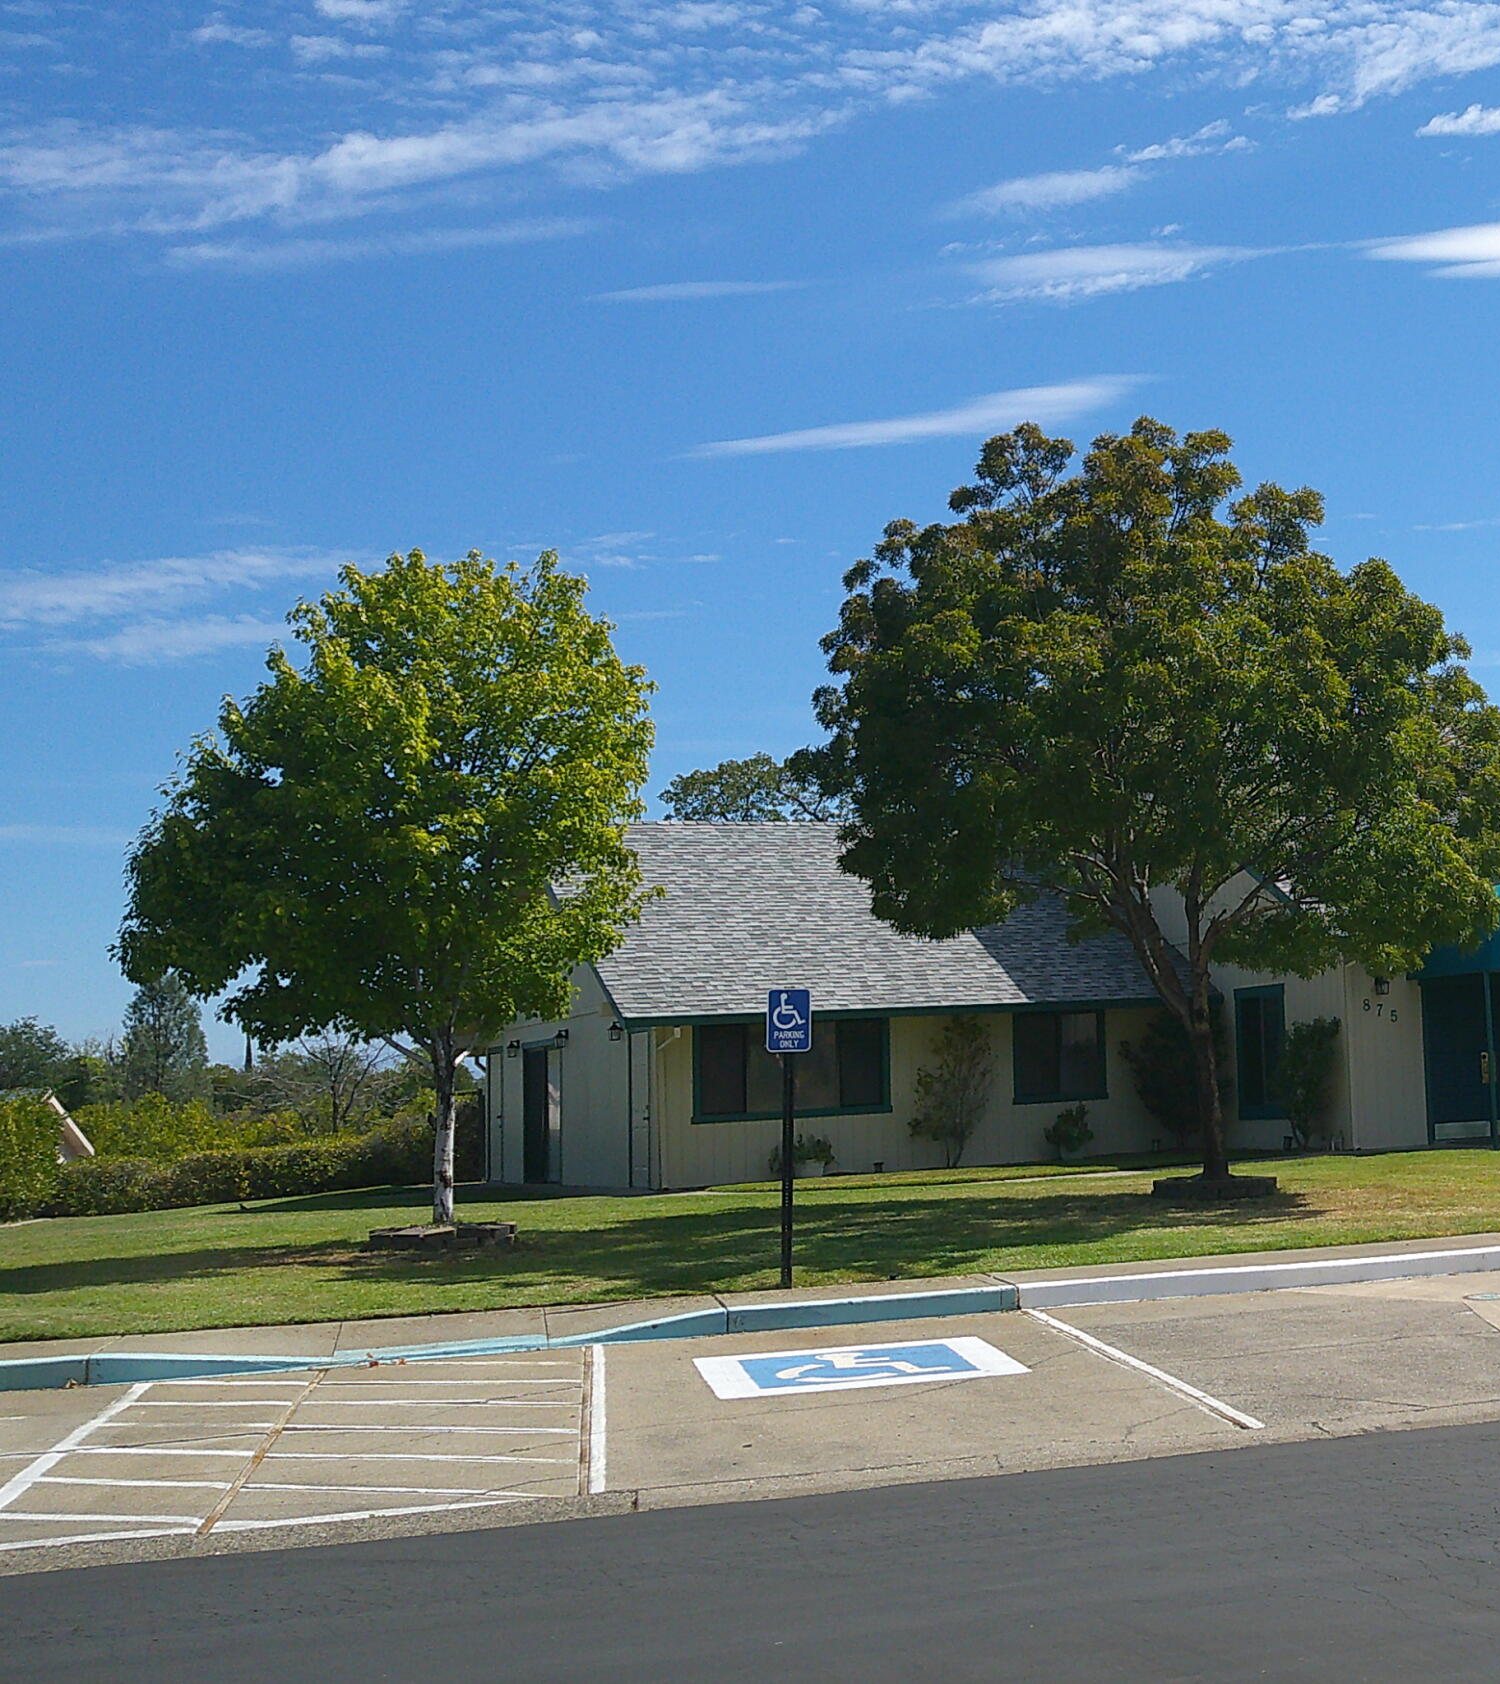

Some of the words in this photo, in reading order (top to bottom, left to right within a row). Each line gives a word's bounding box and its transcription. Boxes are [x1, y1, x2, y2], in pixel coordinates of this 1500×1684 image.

[1362, 998, 1398, 1023] 875
[773, 1030, 805, 1039] PARKING
[779, 1039, 799, 1048] ONLY
